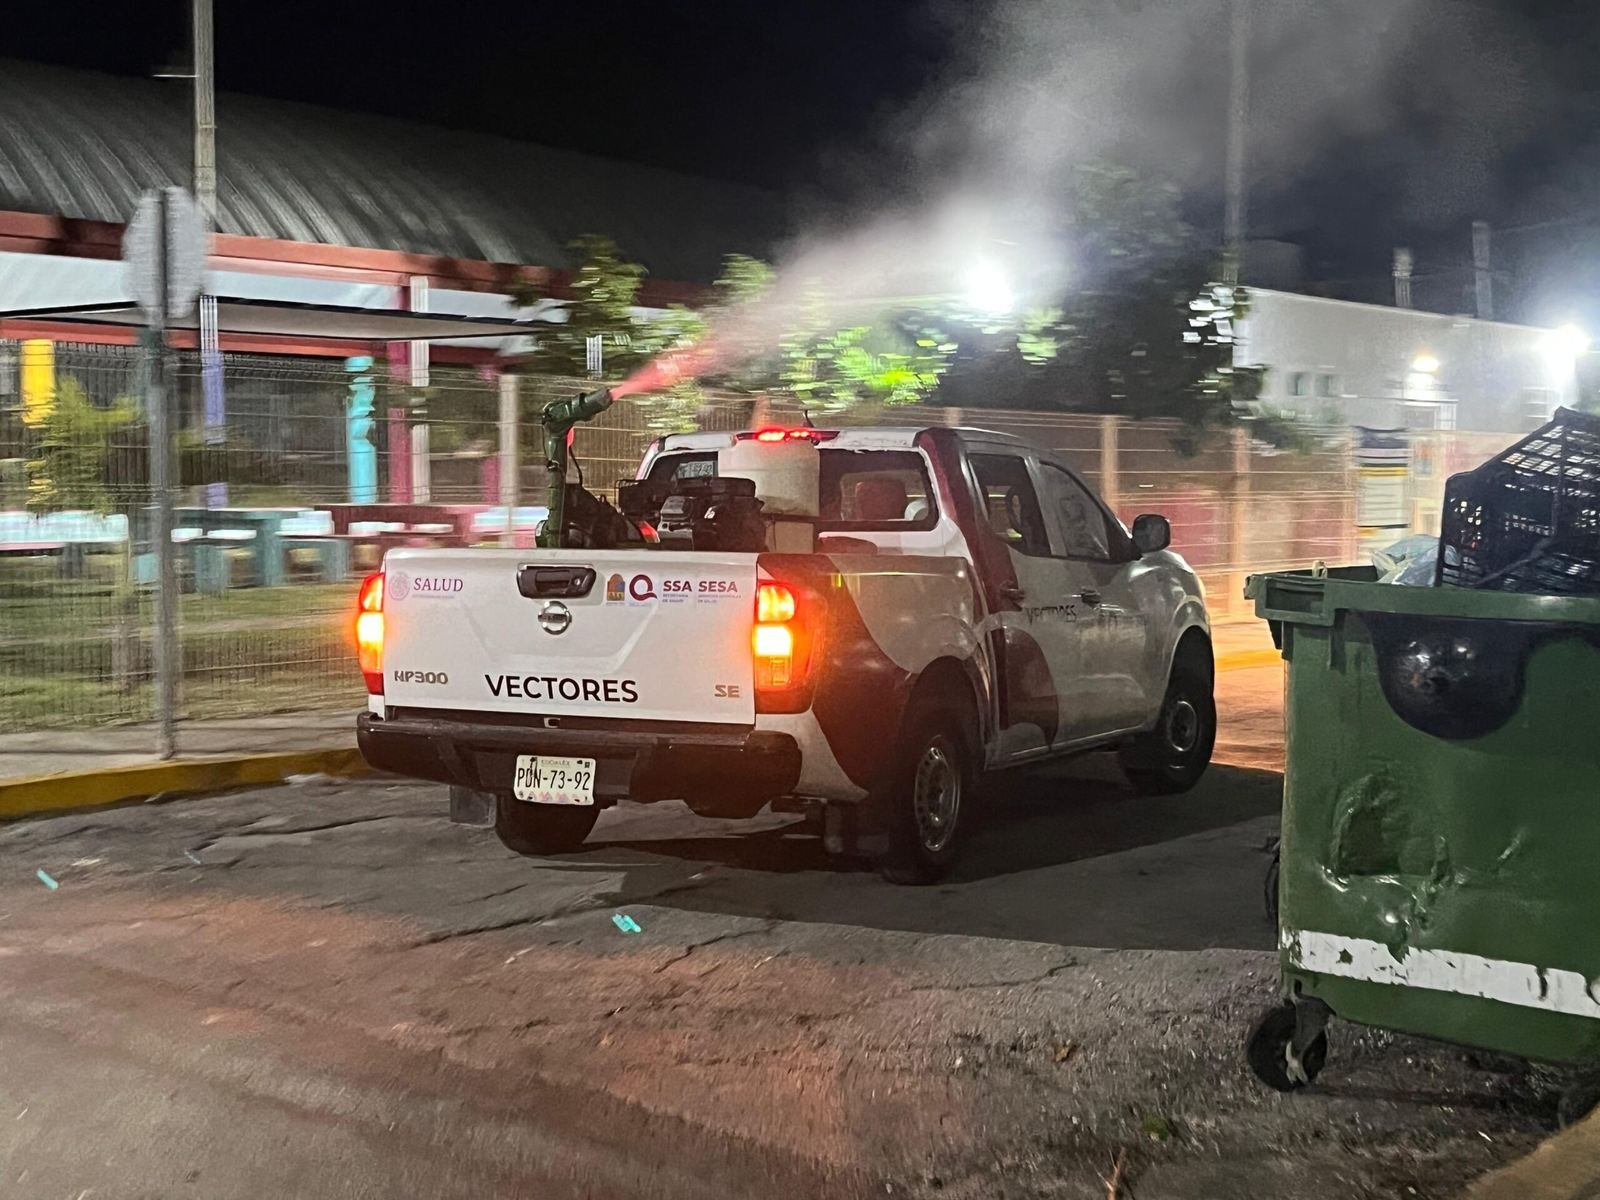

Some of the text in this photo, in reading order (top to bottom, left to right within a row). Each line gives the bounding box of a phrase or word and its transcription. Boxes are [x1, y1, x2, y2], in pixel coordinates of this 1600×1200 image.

[414, 577, 464, 592] SALUD
[663, 580, 693, 592] SSA
[698, 581, 738, 593] SESA
[394, 670, 449, 685] NP300
[484, 674, 639, 703] VECTORES
[714, 684, 740, 698] SE
